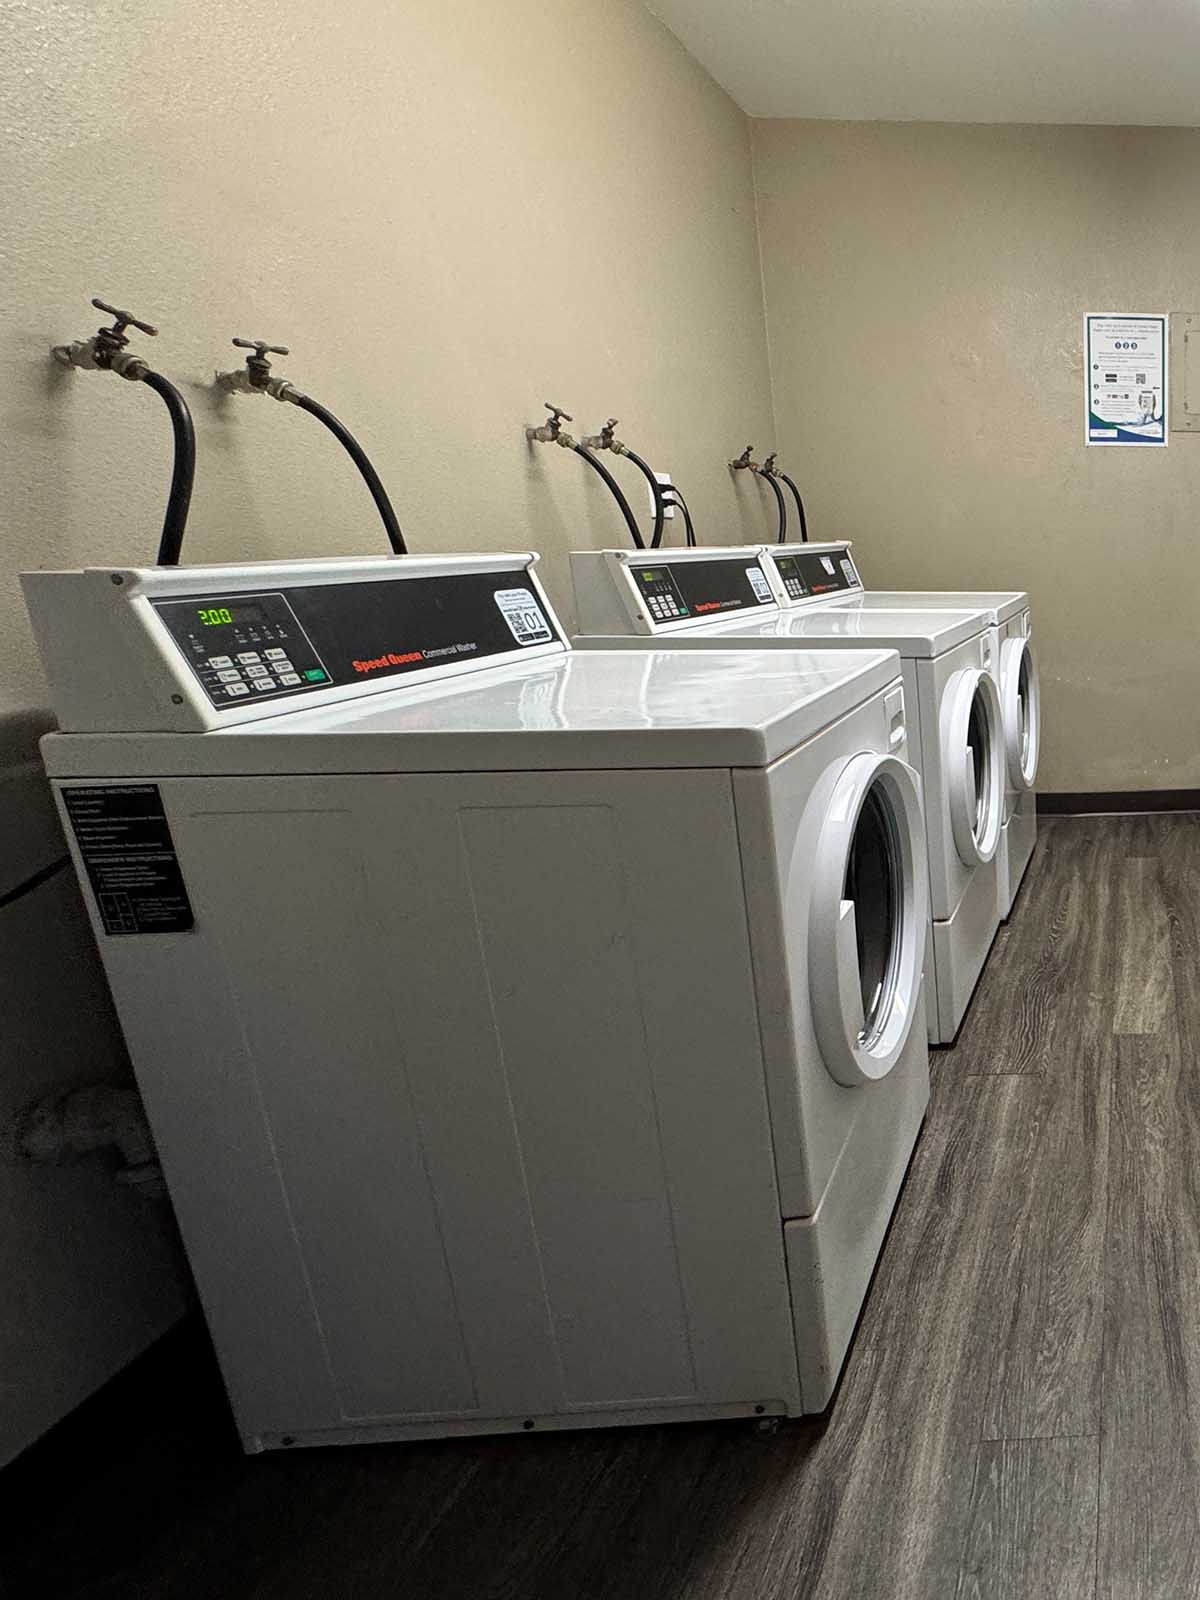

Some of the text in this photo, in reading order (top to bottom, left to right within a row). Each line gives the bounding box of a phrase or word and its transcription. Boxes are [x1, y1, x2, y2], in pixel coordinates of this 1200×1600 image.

[523, 611, 546, 630] 01
[352, 655, 390, 672] Speed
[387, 651, 423, 665] Queen
